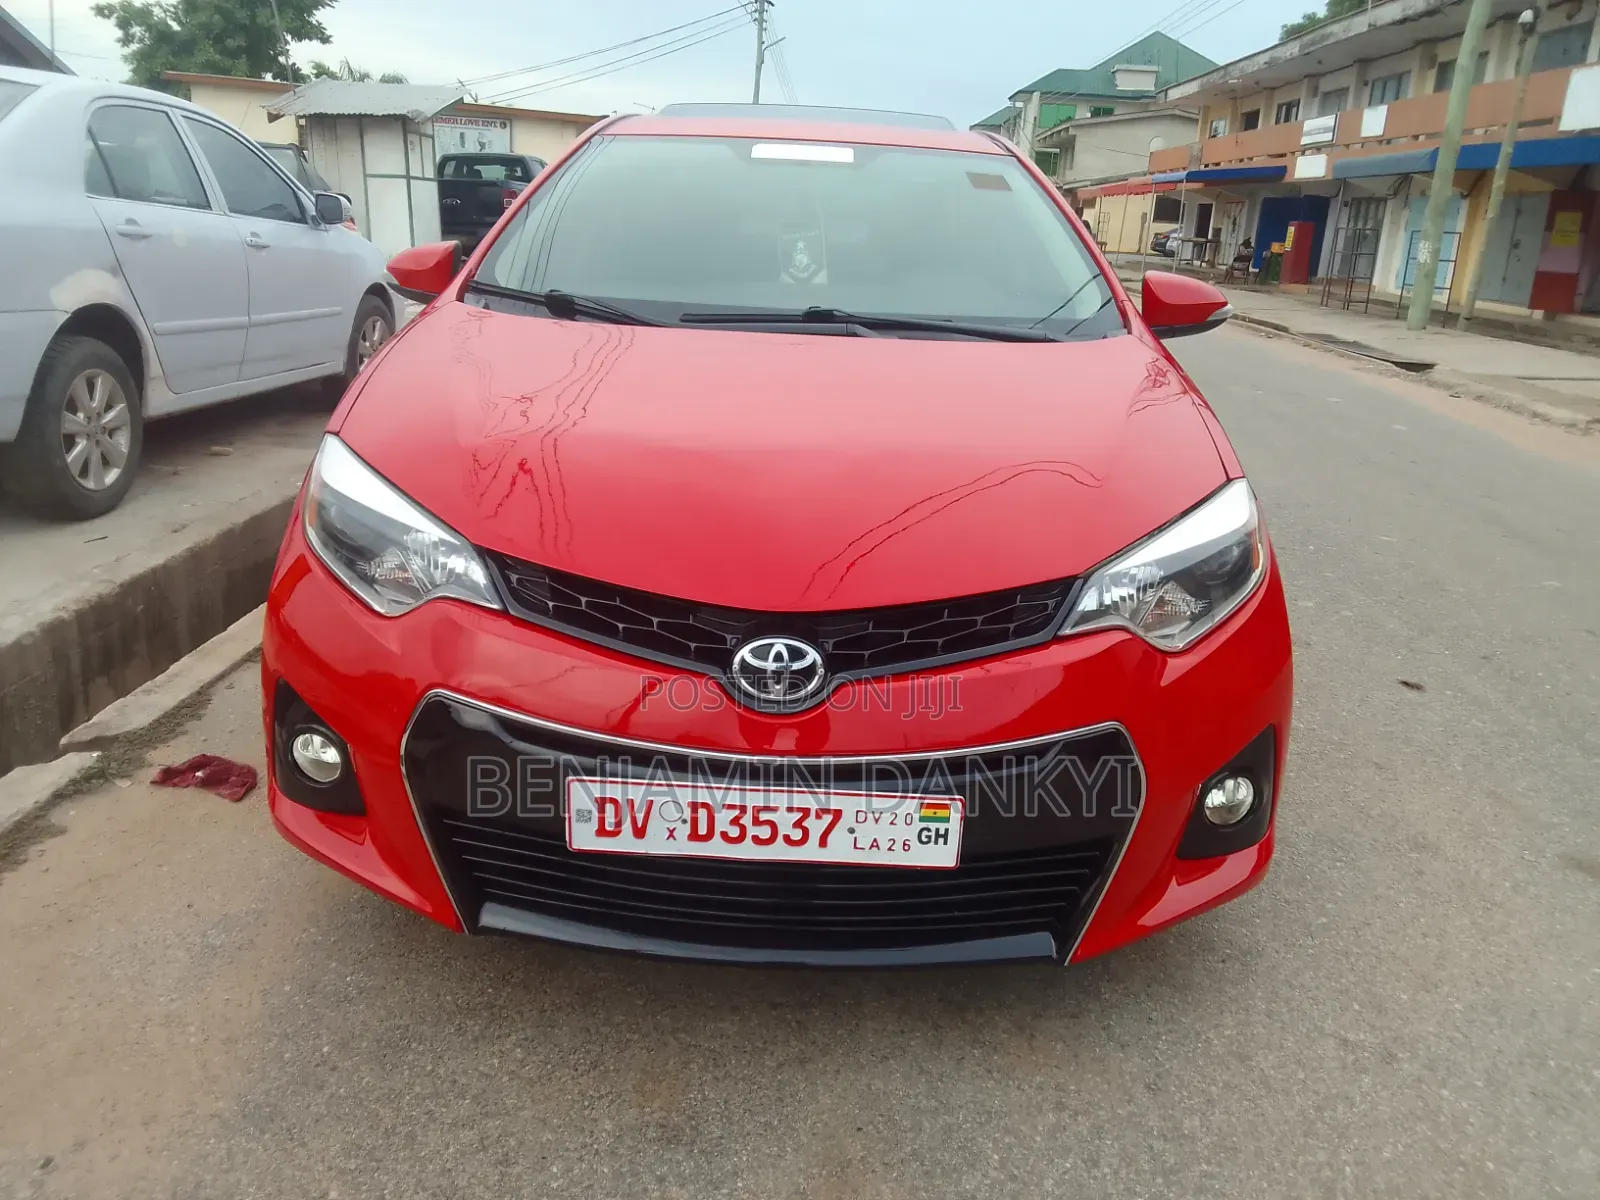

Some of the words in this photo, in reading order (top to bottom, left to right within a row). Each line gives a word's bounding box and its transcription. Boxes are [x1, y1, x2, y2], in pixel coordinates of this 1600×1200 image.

[459, 118, 480, 127] LOVE
[594, 796, 654, 840] DV
[687, 801, 842, 848] D3537
[917, 827, 950, 846] GH
